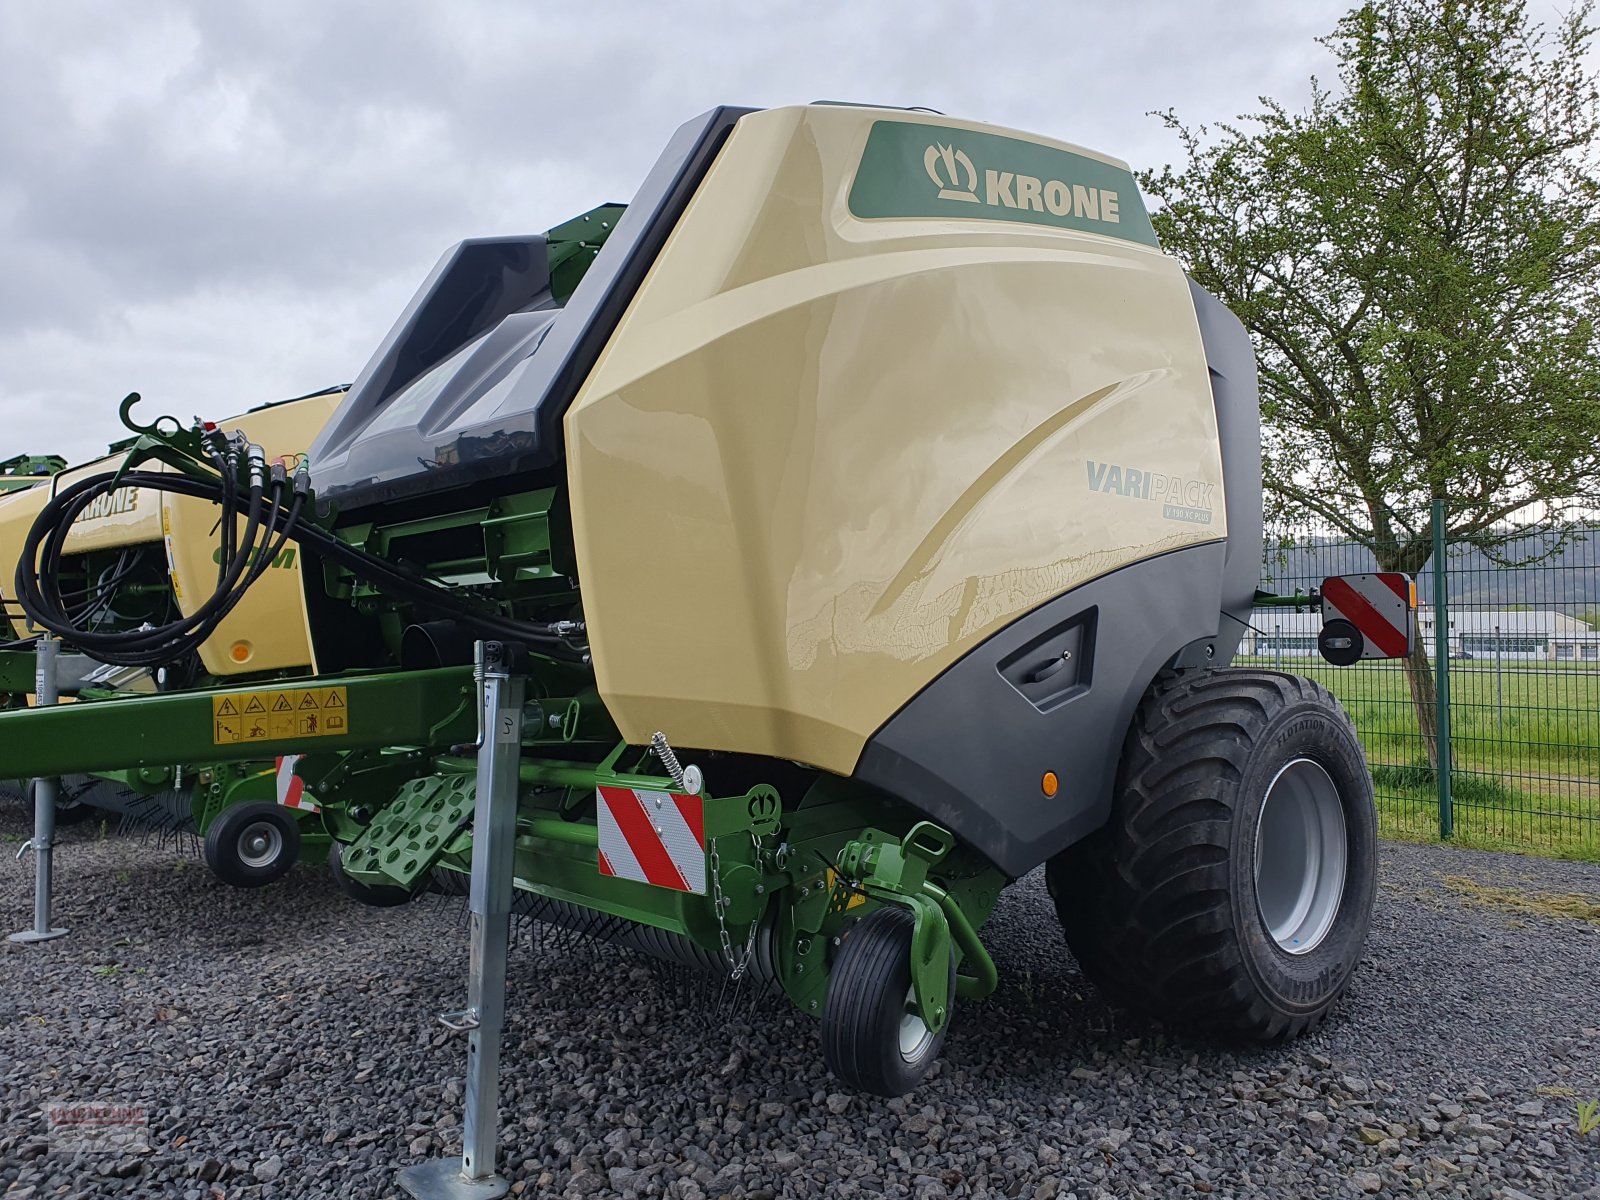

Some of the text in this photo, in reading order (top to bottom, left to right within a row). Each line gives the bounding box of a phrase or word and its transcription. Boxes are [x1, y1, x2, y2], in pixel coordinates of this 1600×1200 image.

[985, 169, 1121, 224] KRONE
[1086, 460, 1215, 510] VARIPACK
[1166, 507, 1209, 522] V 190 XC PLUS
[1276, 719, 1325, 748] FLOTATION
